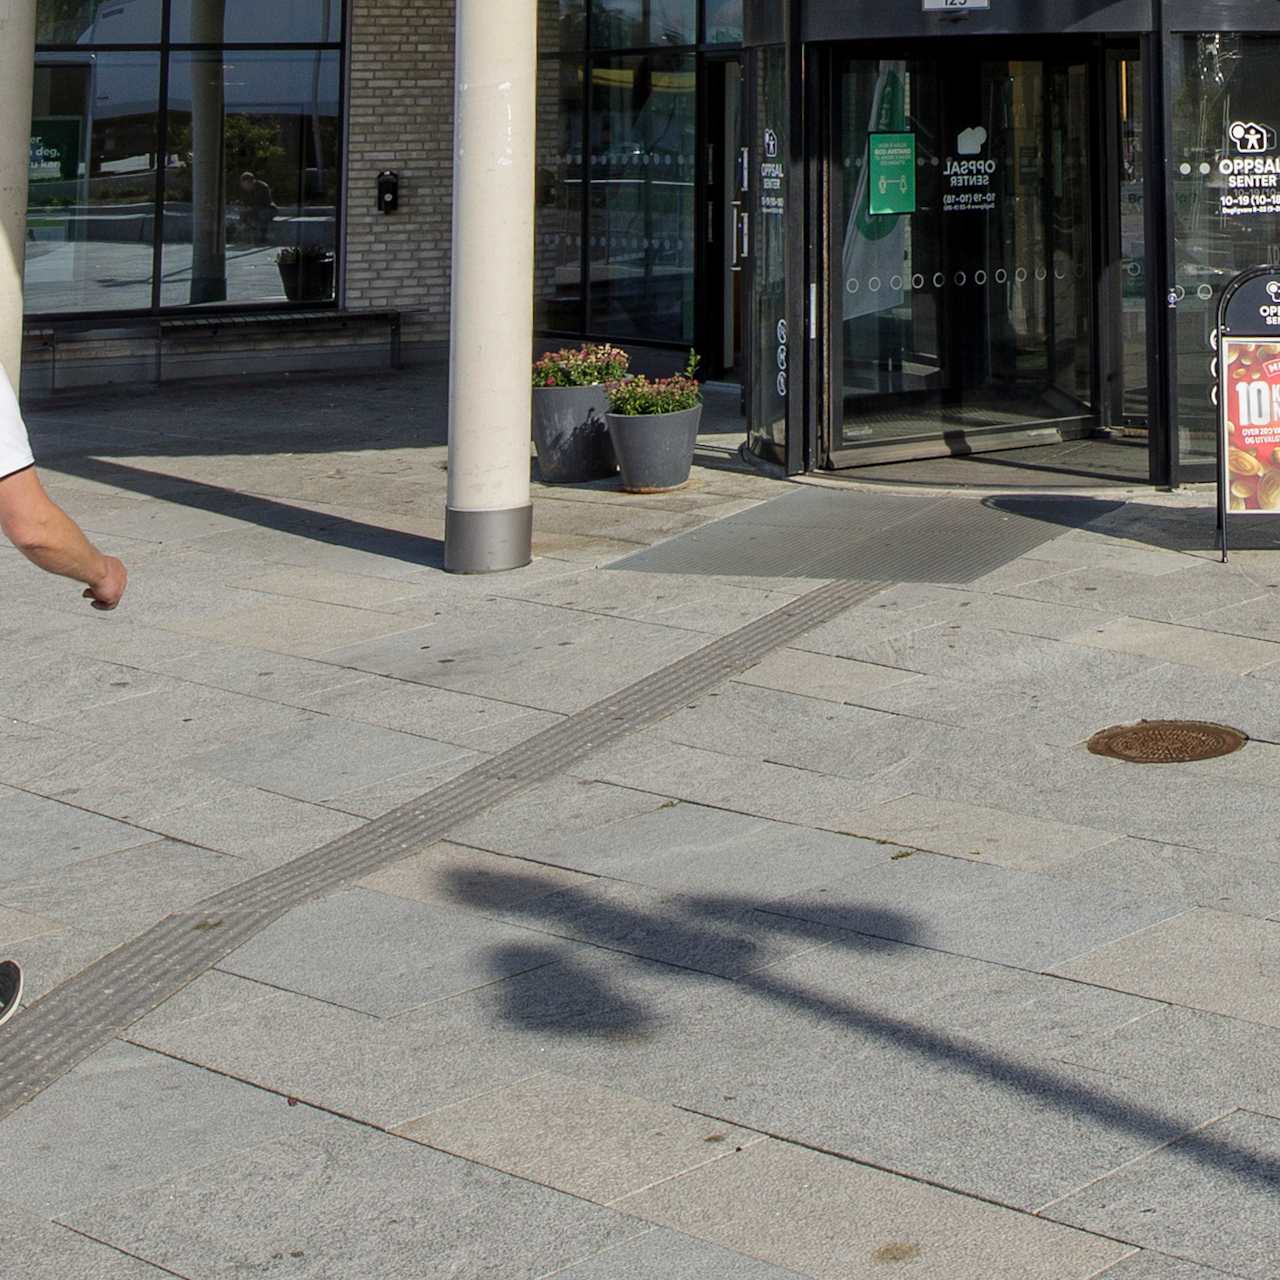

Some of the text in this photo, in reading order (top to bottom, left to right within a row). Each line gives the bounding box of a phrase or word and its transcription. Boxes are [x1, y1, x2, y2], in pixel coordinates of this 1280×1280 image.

[1228, 174, 1277, 188] SENTER
[1220, 195, 1249, 206] 10-19
[1236, 381, 1271, 426] 10
[1242, 427, 1259, 436] OVER
